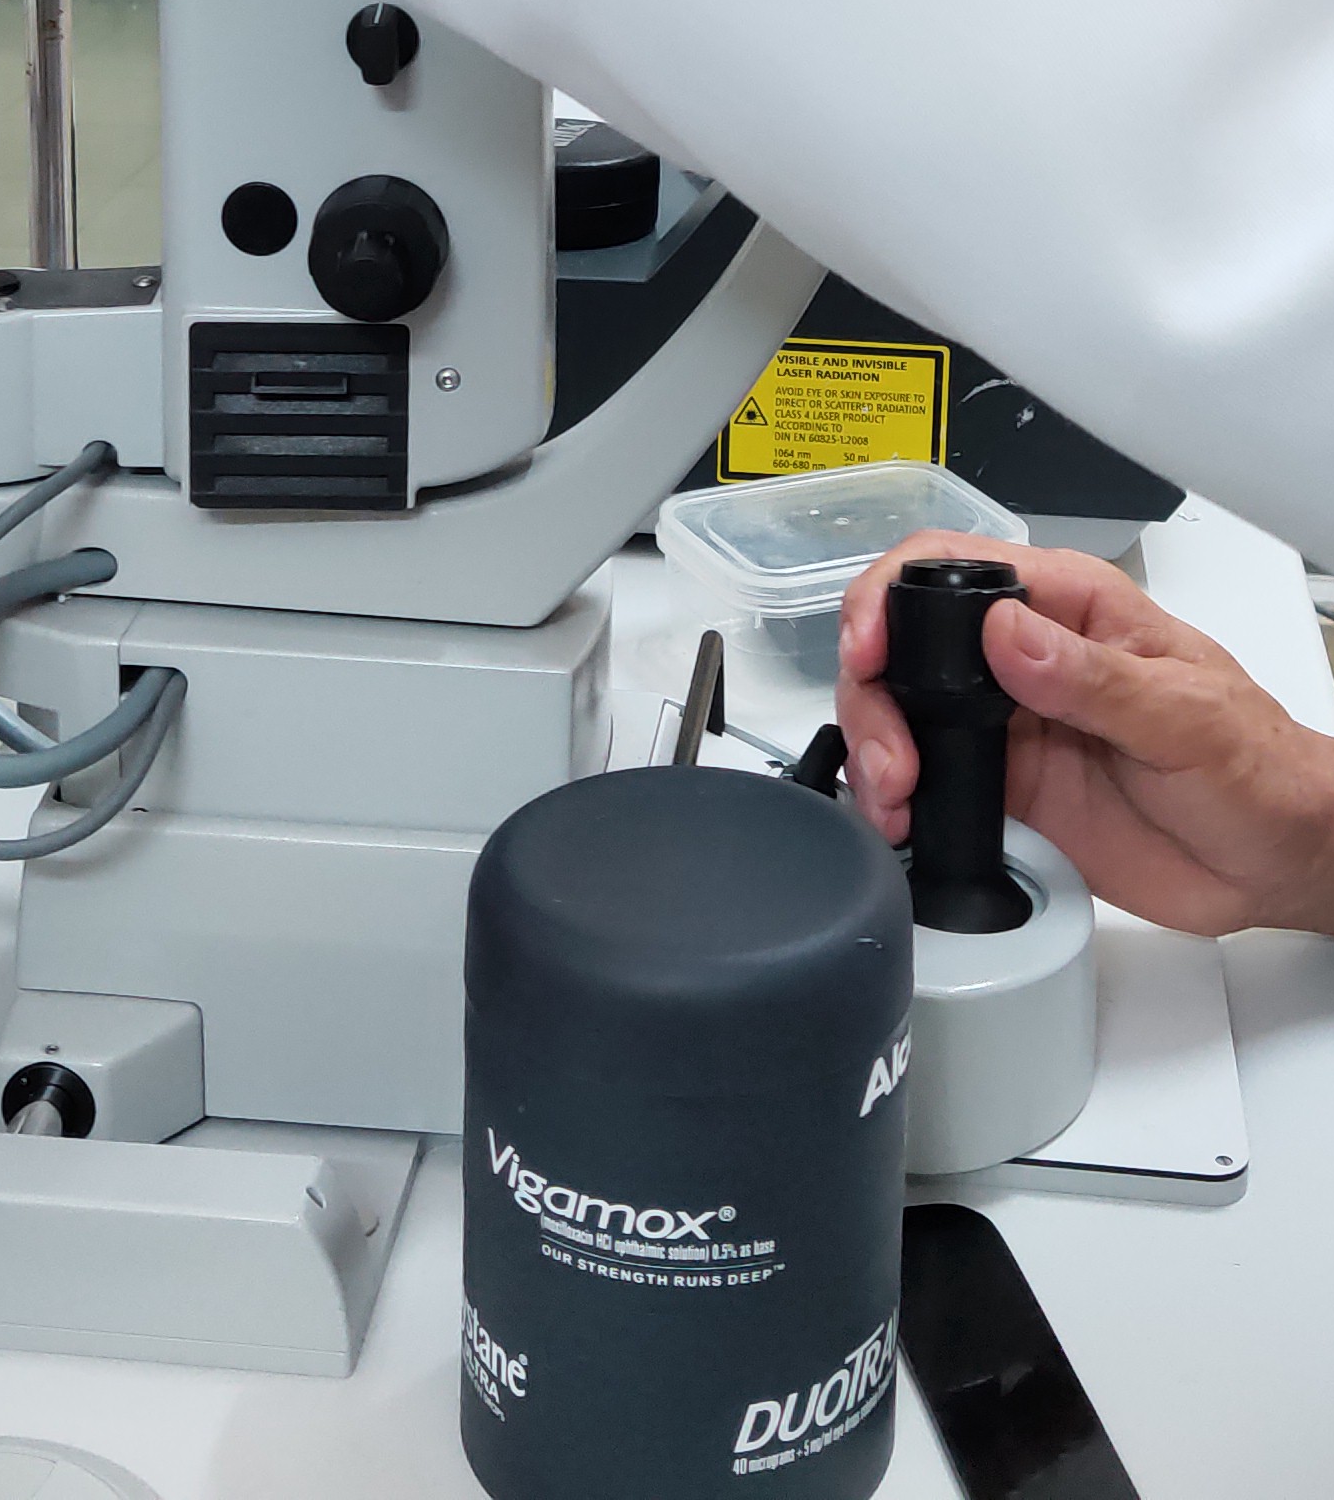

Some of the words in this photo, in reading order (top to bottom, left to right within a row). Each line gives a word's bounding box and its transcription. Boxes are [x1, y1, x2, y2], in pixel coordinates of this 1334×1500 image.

[777, 354, 819, 366] VISIBLE
[822, 357, 848, 368] AND
[852, 359, 908, 371] INVISIBLE
[777, 368, 812, 378] LASER
[817, 370, 880, 382] RADIATION
[775, 386, 803, 397] AVOID
[806, 388, 821, 398] EYE
[825, 389, 838, 399] OR
[840, 390, 861, 400] SKIN
[864, 391, 911, 403] EXPOSURE
[914, 394, 925, 403] TO
[775, 398, 807, 408] DIRECT
[809, 399, 822, 409] OR
[825, 401, 873, 412] SCATTERED
[876, 403, 926, 415] RADIATION
[775, 409, 802, 419] CLASS
[804, 411, 810, 420] 4
[813, 411, 840, 421] LASER
[843, 413, 885, 424] PRODUCT
[775, 421, 828, 432] ACCORDING
[831, 423, 843, 432] TO
[774, 432, 790, 442] DIN
[793, 433, 806, 443] EN
[774, 449, 794, 458] 1064
[797, 451, 811, 459] nm
[773, 460, 810, 470] 660-680
[541, 1243, 573, 1266] OUR
[577, 1258, 668, 1287] STRENGTH
[673, 1275, 722, 1287] RUNS
